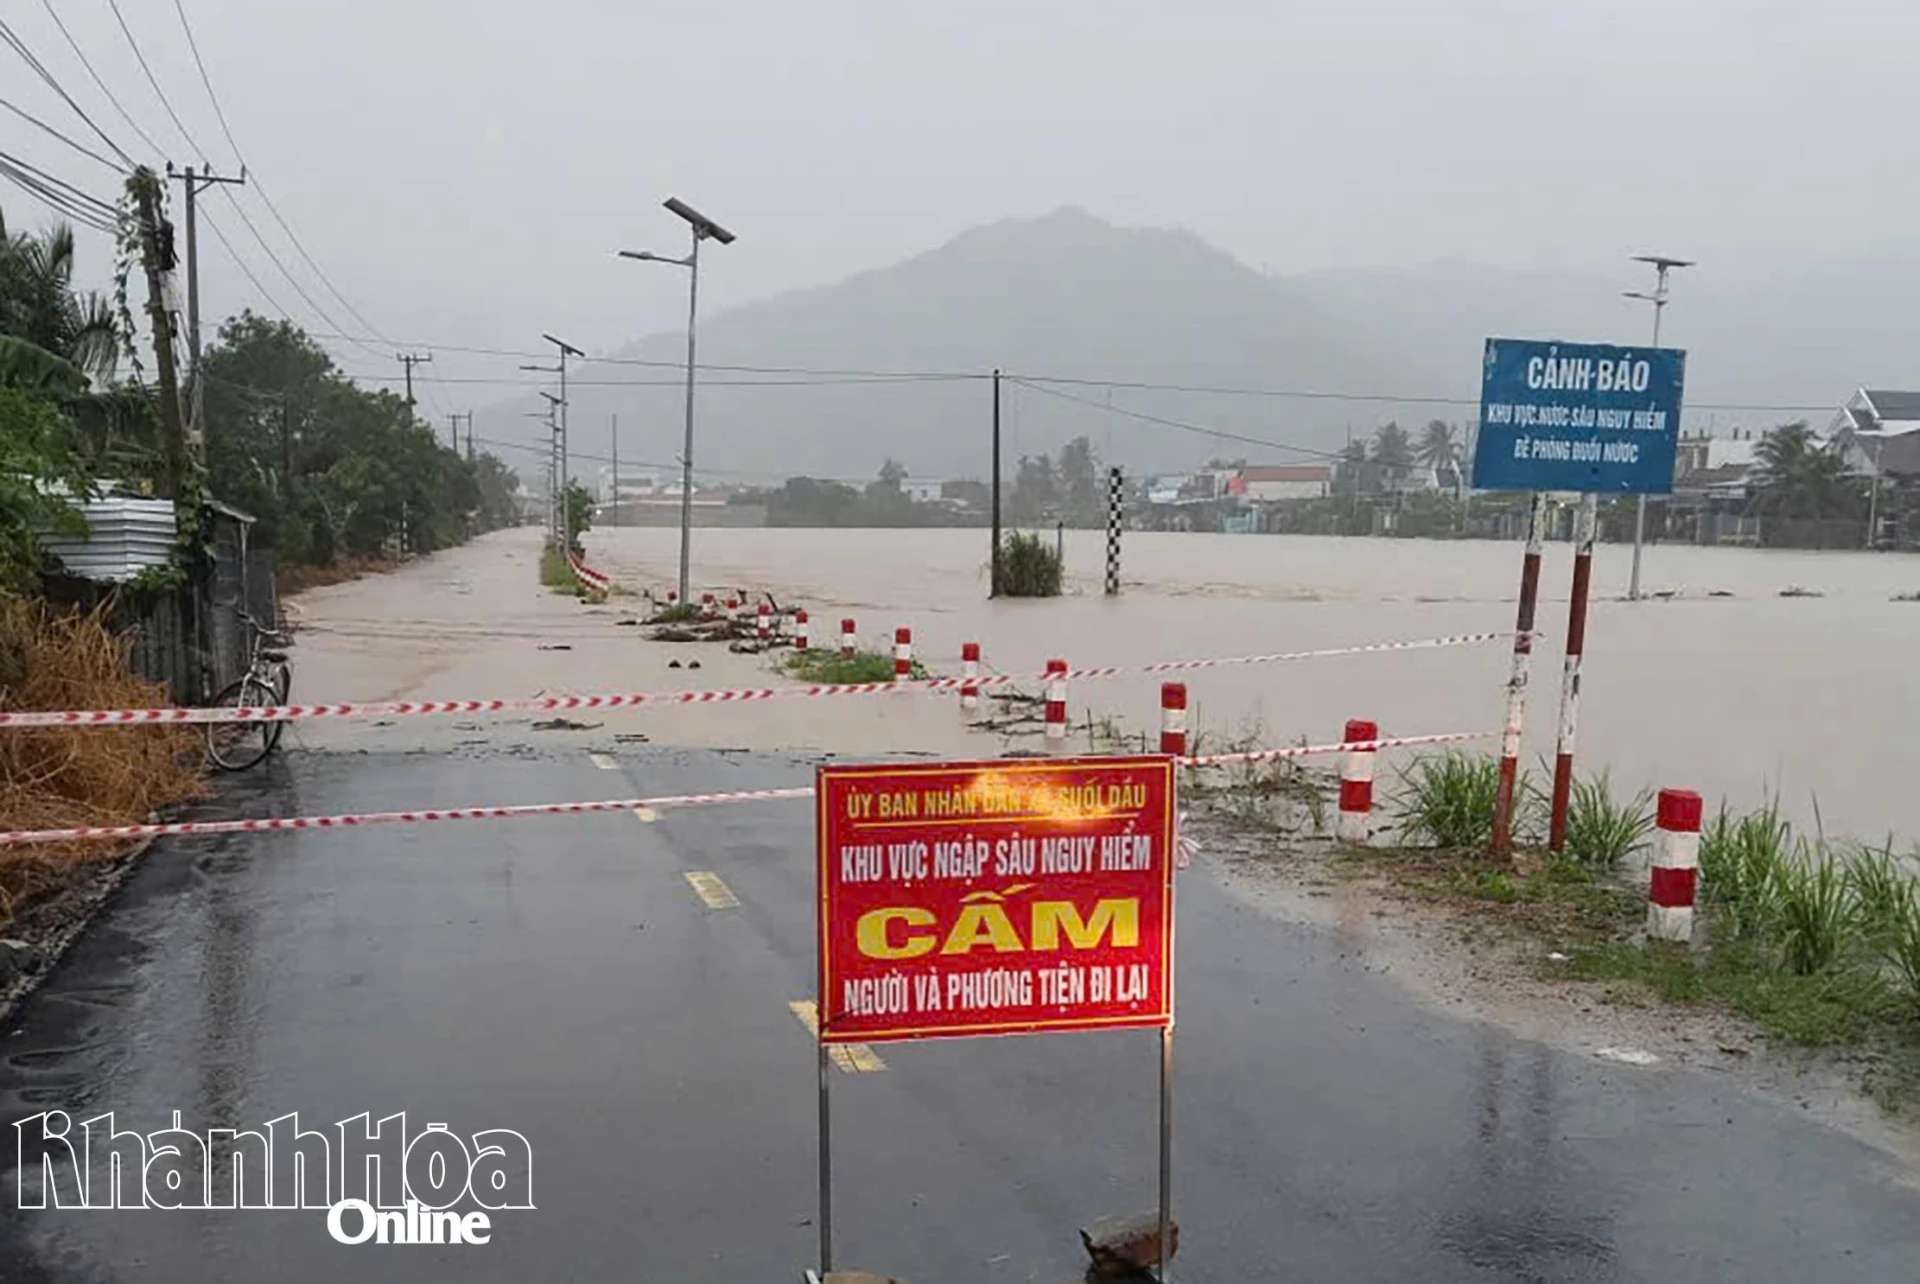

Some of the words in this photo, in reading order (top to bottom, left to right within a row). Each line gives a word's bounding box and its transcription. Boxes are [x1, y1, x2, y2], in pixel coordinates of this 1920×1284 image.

[1488, 403, 1512, 424] KHU
[1597, 409, 1631, 430] NGUY
[879, 792, 917, 818] BAN
[925, 784, 976, 817] NHÂN
[841, 845, 883, 882] KHU
[889, 842, 928, 887] VỰC
[934, 833, 989, 886] NGẬP
[995, 831, 1036, 877] SÂU
[1041, 836, 1096, 874] NGUY
[1101, 819, 1151, 871] HIỂM
[856, 882, 1140, 960] CẤM
[844, 972, 909, 1017] NGƯỜI
[915, 966, 941, 1013] VÀ
[947, 969, 1032, 1011] PHƯƠNG
[1038, 961, 1084, 1013] TIỆN
[1090, 966, 1112, 1003] ĐI
[1117, 964, 1149, 1009] LẠI
